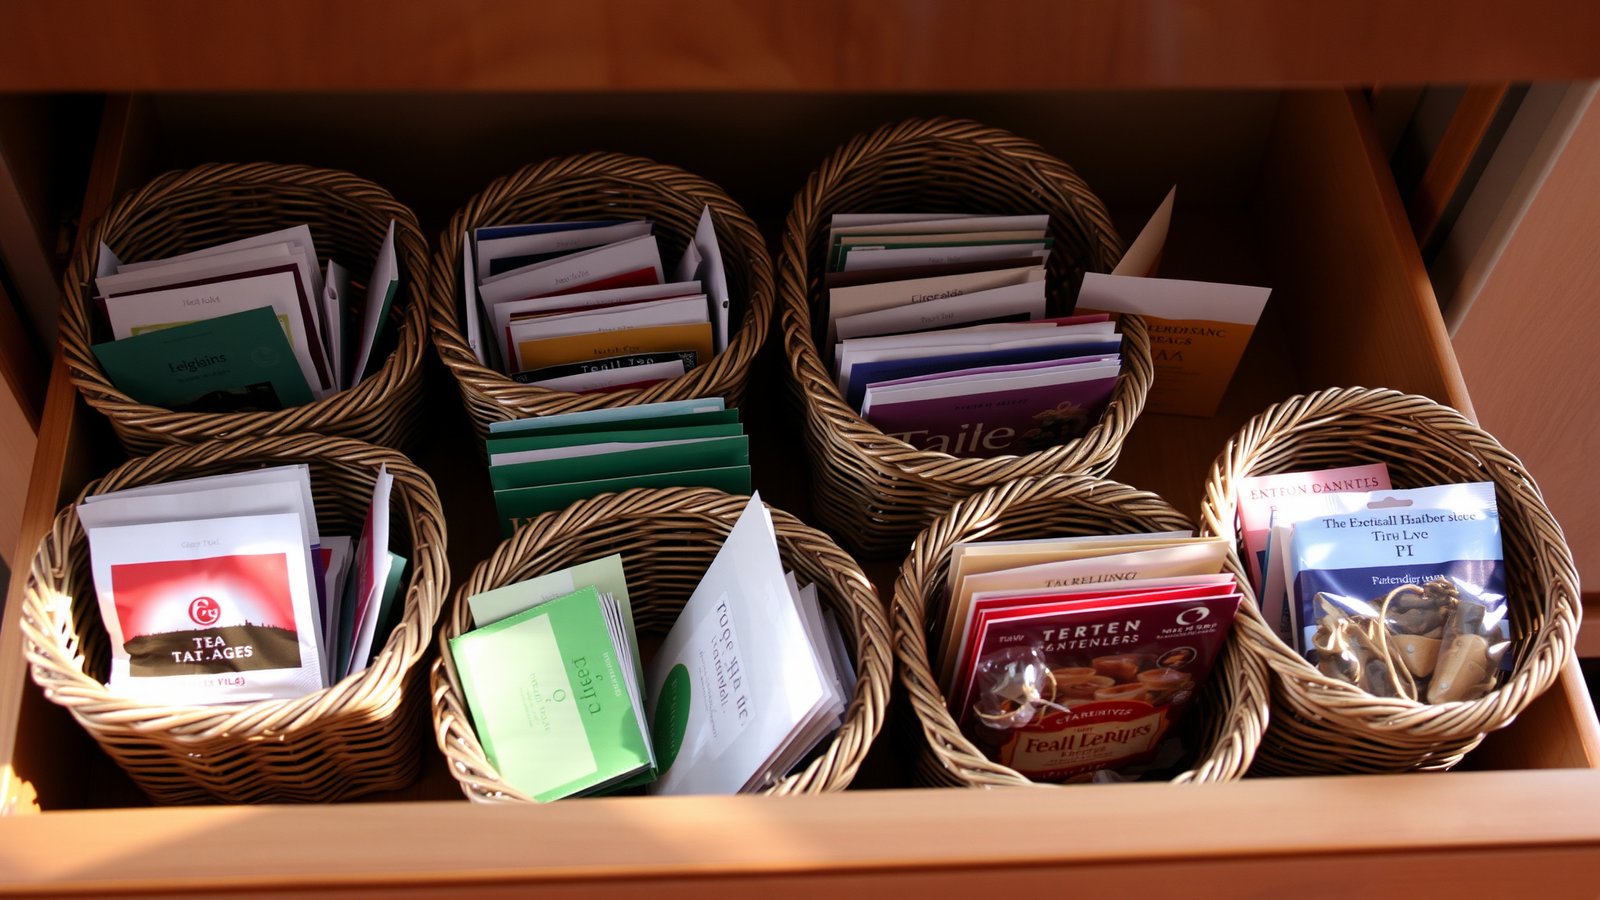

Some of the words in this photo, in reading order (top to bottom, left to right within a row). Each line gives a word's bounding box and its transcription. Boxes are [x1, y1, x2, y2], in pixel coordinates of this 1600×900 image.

[1323, 517, 1346, 528] The
[1042, 619, 1141, 642] TERTEN
[192, 635, 226, 649] TEA
